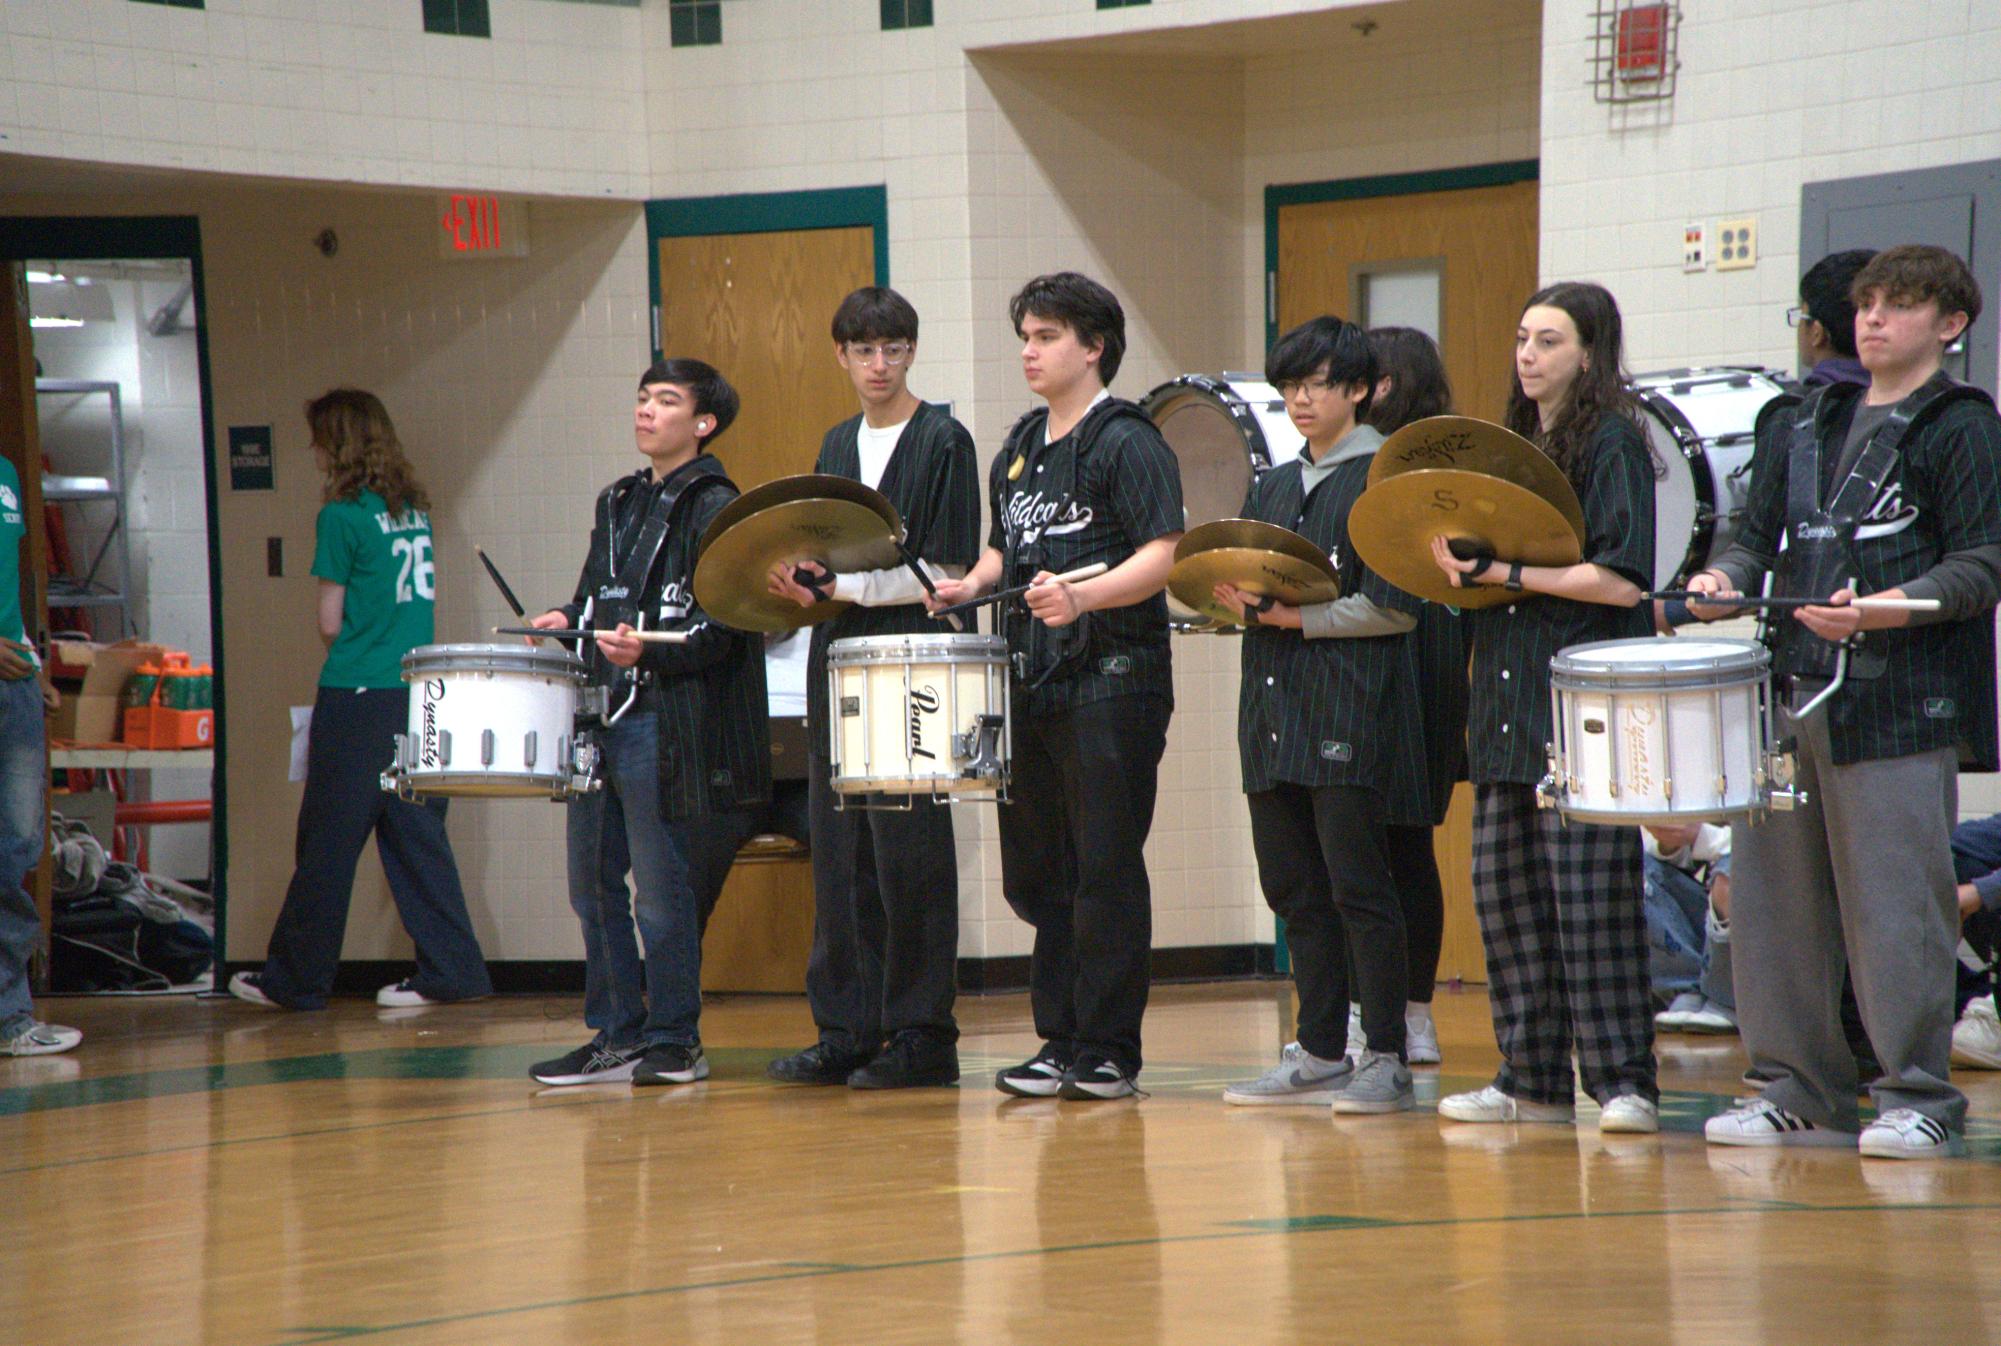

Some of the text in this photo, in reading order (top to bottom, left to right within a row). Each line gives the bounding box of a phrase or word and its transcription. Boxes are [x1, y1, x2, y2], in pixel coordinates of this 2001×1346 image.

[391, 534, 435, 604] 26
[196, 716, 210, 742] G
[421, 677, 446, 768] Dynasty
[904, 684, 940, 761] Pearl
